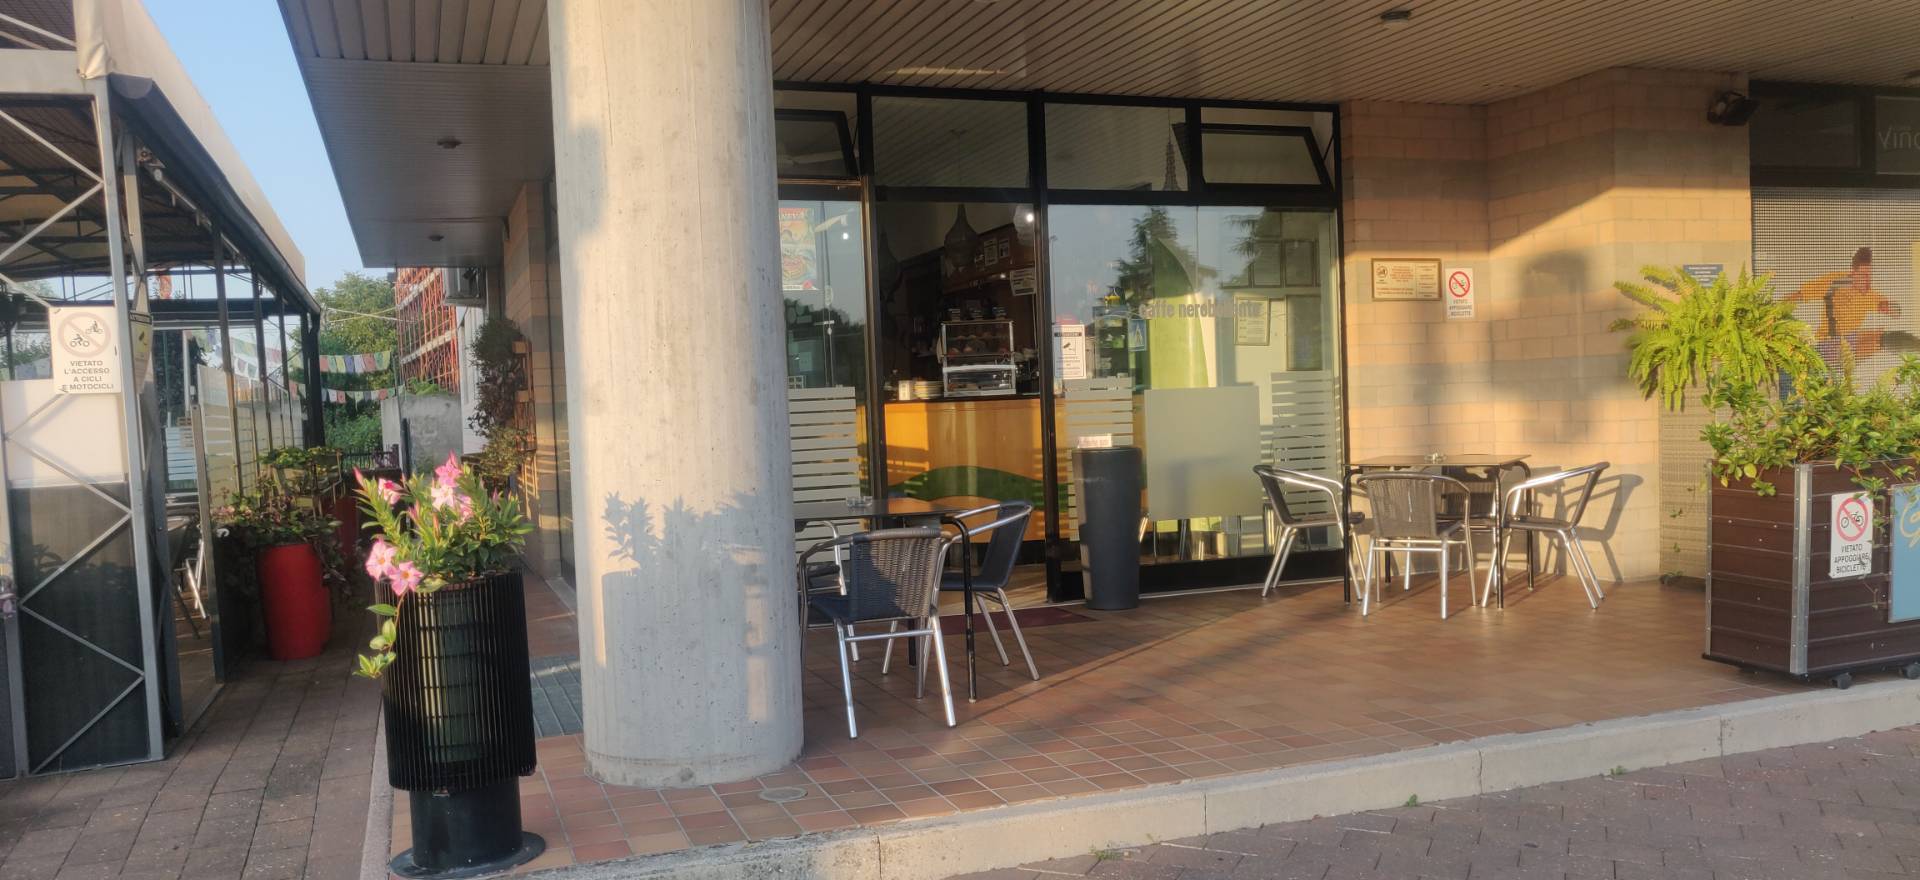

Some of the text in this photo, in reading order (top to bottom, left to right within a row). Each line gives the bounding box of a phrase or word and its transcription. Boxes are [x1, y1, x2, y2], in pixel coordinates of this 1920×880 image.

[1178, 299, 1261, 318] nerobente
[64, 367, 110, 375] L'ACCESSO
[1841, 543, 1863, 552] VIETATO
